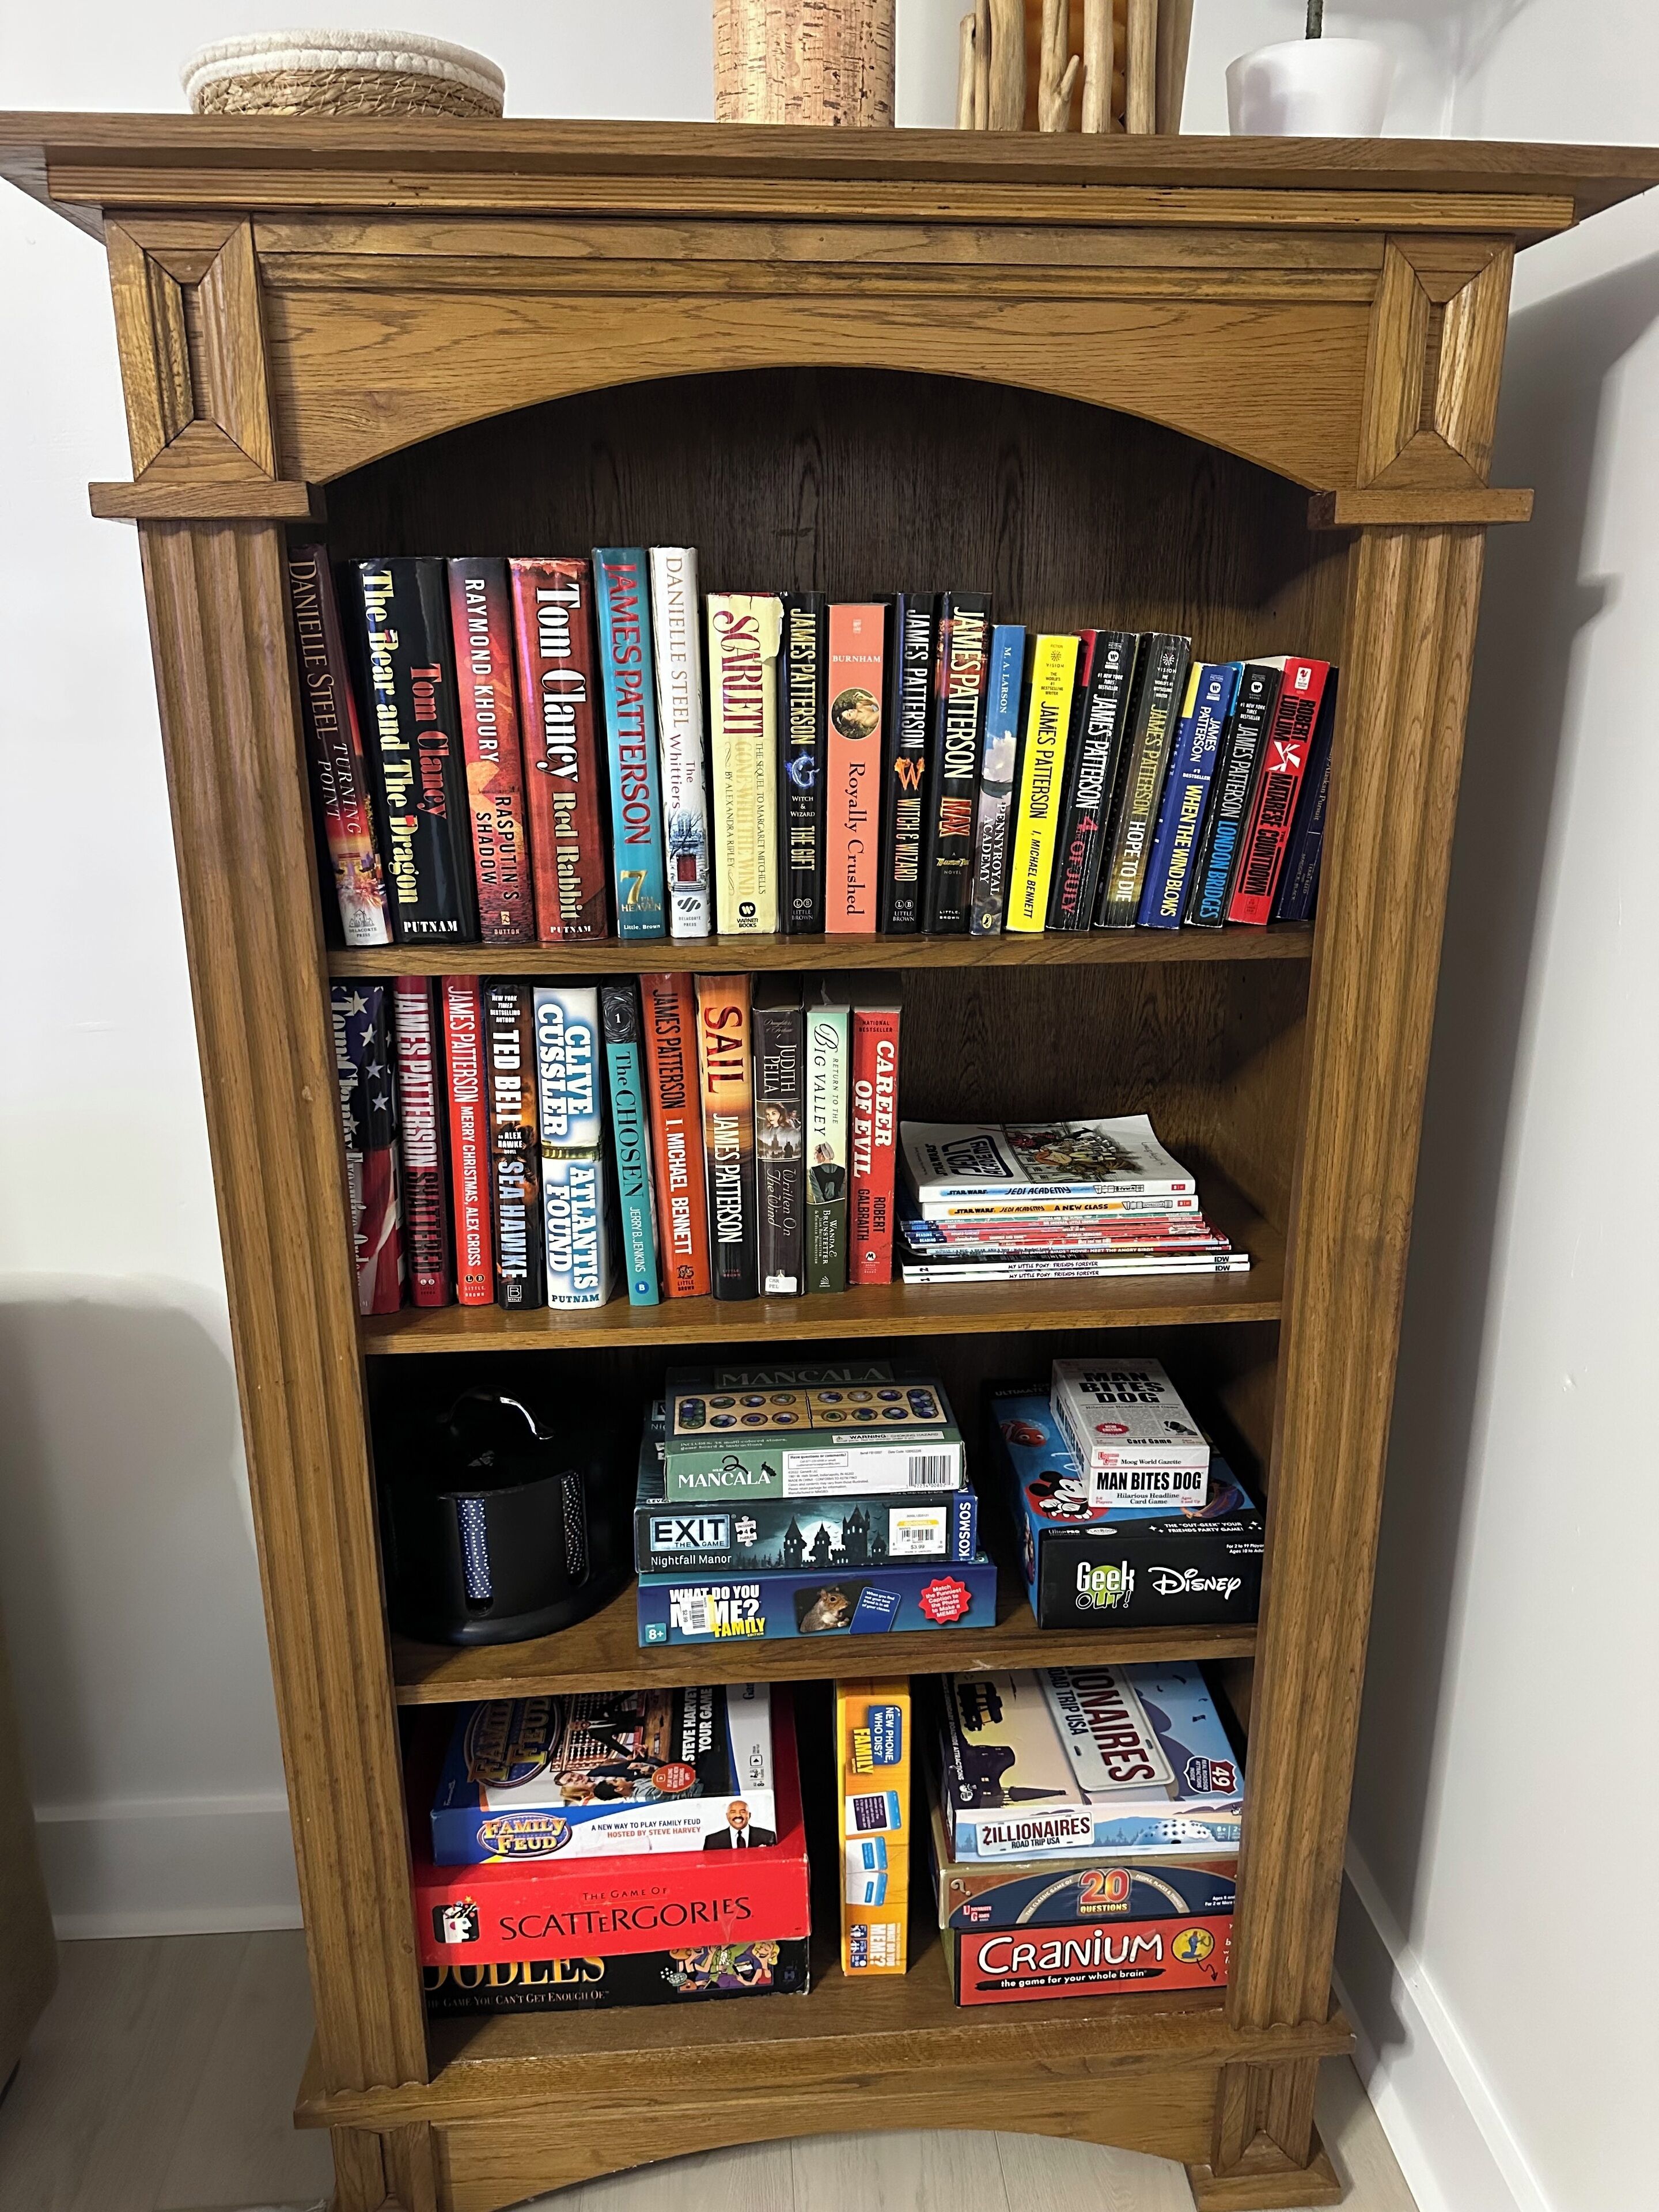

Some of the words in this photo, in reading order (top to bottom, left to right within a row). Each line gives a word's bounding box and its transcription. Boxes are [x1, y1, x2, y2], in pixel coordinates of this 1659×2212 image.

[289, 560, 327, 668] DANIELLE
[362, 570, 395, 623] The
[603, 563, 641, 665] JAMES
[666, 557, 687, 663] DANIELLE
[465, 578, 492, 675] RAYMOND
[536, 582, 581, 658] Tom
[952, 607, 984, 669] JAMES
[368, 628, 398, 696] Bear
[713, 610, 763, 738] SCARLETT
[832, 655, 881, 663] BURNHAM
[307, 672, 339, 740] STEEL
[410, 663, 442, 722] Tom
[670, 667, 688, 728] STEEL
[377, 704, 409, 751] and
[474, 684, 499, 763] KHOURY
[537, 669, 586, 783] Clancy
[944, 670, 980, 779] PATTERSON
[1146, 704, 1168, 746] JAMES
[1291, 699, 1316, 744] ROBERT
[417, 731, 450, 819] Clancy
[615, 669, 652, 846] PATTERSON
[669, 734, 680, 810] Whittiers
[685, 759, 695, 784] The
[725, 771, 732, 781] BY
[318, 760, 340, 821] POINT
[334, 743, 361, 834] TURNING
[383, 758, 414, 807] The
[844, 762, 866, 833] Royally
[1133, 748, 1158, 816] PATTERSON
[552, 791, 578, 841] Red
[726, 784, 734, 839] ALEXANDRA
[939, 796, 972, 838] MAX
[1180, 785, 1203, 824] WHEN
[475, 812, 498, 886] SHADOW
[727, 840, 735, 868] RIPLEY
[791, 825, 815, 845] THE
[979, 815, 993, 884] ACADEMY
[990, 804, 1007, 896] PENNYROYAL
[1124, 820, 1146, 856] HOPE
[1175, 824, 1195, 847] THE
[389, 815, 418, 904] Dragon
[791, 846, 815, 872] GIFT
[845, 838, 866, 915] Crushed
[1120, 860, 1138, 878] TO
[1168, 848, 1189, 878] WIND
[553, 845, 582, 921] Rabbit
[1115, 880, 1135, 902] DIE
[1160, 879, 1183, 917] BLOWS
[403, 921, 458, 934] PUTNAM
[550, 925, 591, 934] PUTNAM
[448, 986, 474, 1031] JAMES
[450, 1033, 479, 1103] PATTERSON
[493, 1029, 520, 1070] TED
[615, 1052, 632, 1085] The
[703, 1006, 743, 1094] SAIL
[775, 1043, 797, 1092] JUDITH
[537, 1003, 569, 1137] CUSSLER
[564, 1025, 591, 1115] CLIVE
[764, 1055, 781, 1093] PELLA
[494, 1075, 522, 1125] BELL
[832, 1093, 838, 1104] TO
[855, 1080, 873, 1115] OF
[875, 1040, 895, 1147] CAREER
[461, 1106, 475, 1142] MERRY
[613, 1088, 644, 1198] CHOSEN
[854, 1117, 872, 1178] EVIL
[463, 1145, 479, 1205] CHRISTMAS,
[498, 1161, 525, 1199] SEA
[783, 1168, 797, 1214] Written
[465, 1207, 479, 1231] ALEX
[546, 1184, 573, 1272] FOUND
[569, 1165, 600, 1290] ATLANTIS
[783, 1218, 797, 1236] On
[828, 1219, 837, 1249] WANDA
[856, 1188, 870, 1241] GALBRAITH
[873, 1196, 886, 1234] ROBERT
[467, 1233, 480, 1267] CROSS
[498, 1203, 527, 1279] HAWKE
[823, 1210, 831, 1264] BRUNSTETTER
[552, 1293, 600, 1304] PUTNAM
[722, 1368, 887, 1385] MANCALA
[1078, 1382, 1165, 1392] BITES
[1083, 1373, 1150, 1382] MAN
[1095, 1392, 1160, 1403] DOG
[679, 1471, 771, 1488] MANCALA
[1097, 1472, 1127, 1490] MAN
[1131, 1472, 1169, 1490] BITES
[1173, 1472, 1202, 1490] DOG
[654, 1519, 725, 1547] EXIT
[959, 1502, 971, 1556] KOSMOS
[651, 1555, 696, 1567] Nightfall
[699, 1555, 732, 1563] Manor
[1076, 1560, 1135, 1592] Geek
[937, 1609, 957, 1618] MEME!
[1075, 1589, 1132, 1610] OUT!
[649, 1630, 664, 1639] 8+
[714, 1618, 766, 1638] FAMILY
[700, 1687, 713, 1719] GAME
[885, 1707, 894, 1728] NEW
[698, 1721, 712, 1752] YOUR
[874, 1712, 883, 1734] WHO
[853, 1728, 874, 1774] FAMILY
[874, 1736, 883, 1758] DIS?
[884, 1730, 894, 1763] PHONE,
[1212, 1767, 1231, 1787] 49
[484, 1818, 567, 1838] FAMILY
[607, 1830, 636, 1839] HOSTED
[672, 1826, 701, 1835] HARVEY
[658, 1819, 682, 1827] FAMILY
[982, 1817, 1090, 1846] ZILLIONAIRES
[496, 1833, 557, 1854] FEUD
[1012, 1839, 1029, 1849] ROAD
[1031, 1838, 1045, 1846] TRIP
[1047, 1837, 1060, 1845] USA
[582, 1892, 607, 1900] THE
[610, 1889, 646, 1898] GAME
[651, 1887, 668, 1895] OF
[1080, 1869, 1130, 1904] 20
[500, 1896, 752, 1940] SCATTERGORIES
[1080, 1903, 1128, 1913] QUESTIONS
[1001, 1979, 1016, 1987] the
[1018, 1978, 1045, 1988] game
[1048, 1975, 1063, 1984] for
[1064, 1974, 1086, 1984] your
[1088, 1971, 1117, 1980] whole
[1119, 1969, 1145, 1978] brain
